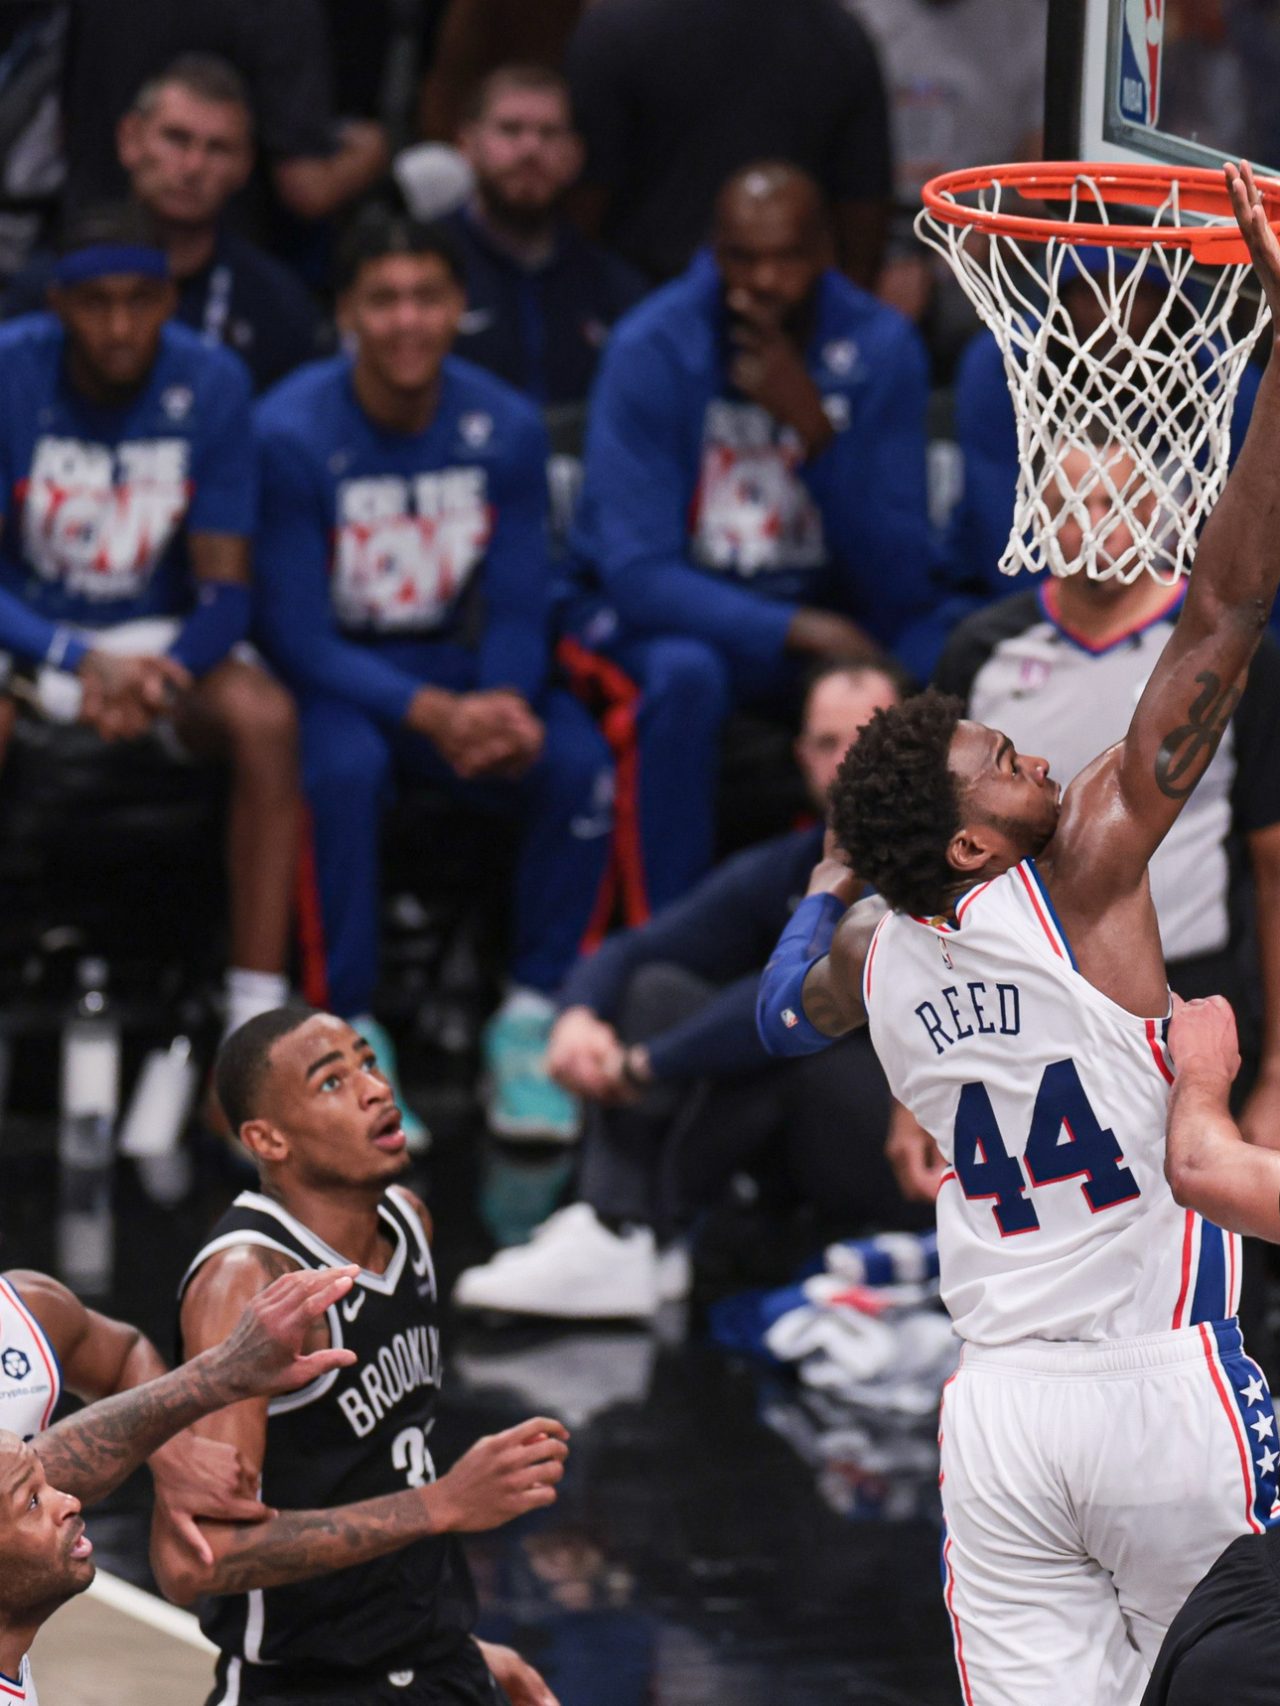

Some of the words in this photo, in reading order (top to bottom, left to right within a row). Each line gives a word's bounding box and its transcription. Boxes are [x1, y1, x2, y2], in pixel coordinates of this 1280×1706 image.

[914, 981, 1020, 1055] REED
[953, 1057, 1141, 1238] 44
[337, 1325, 443, 1438] BROOKLY
